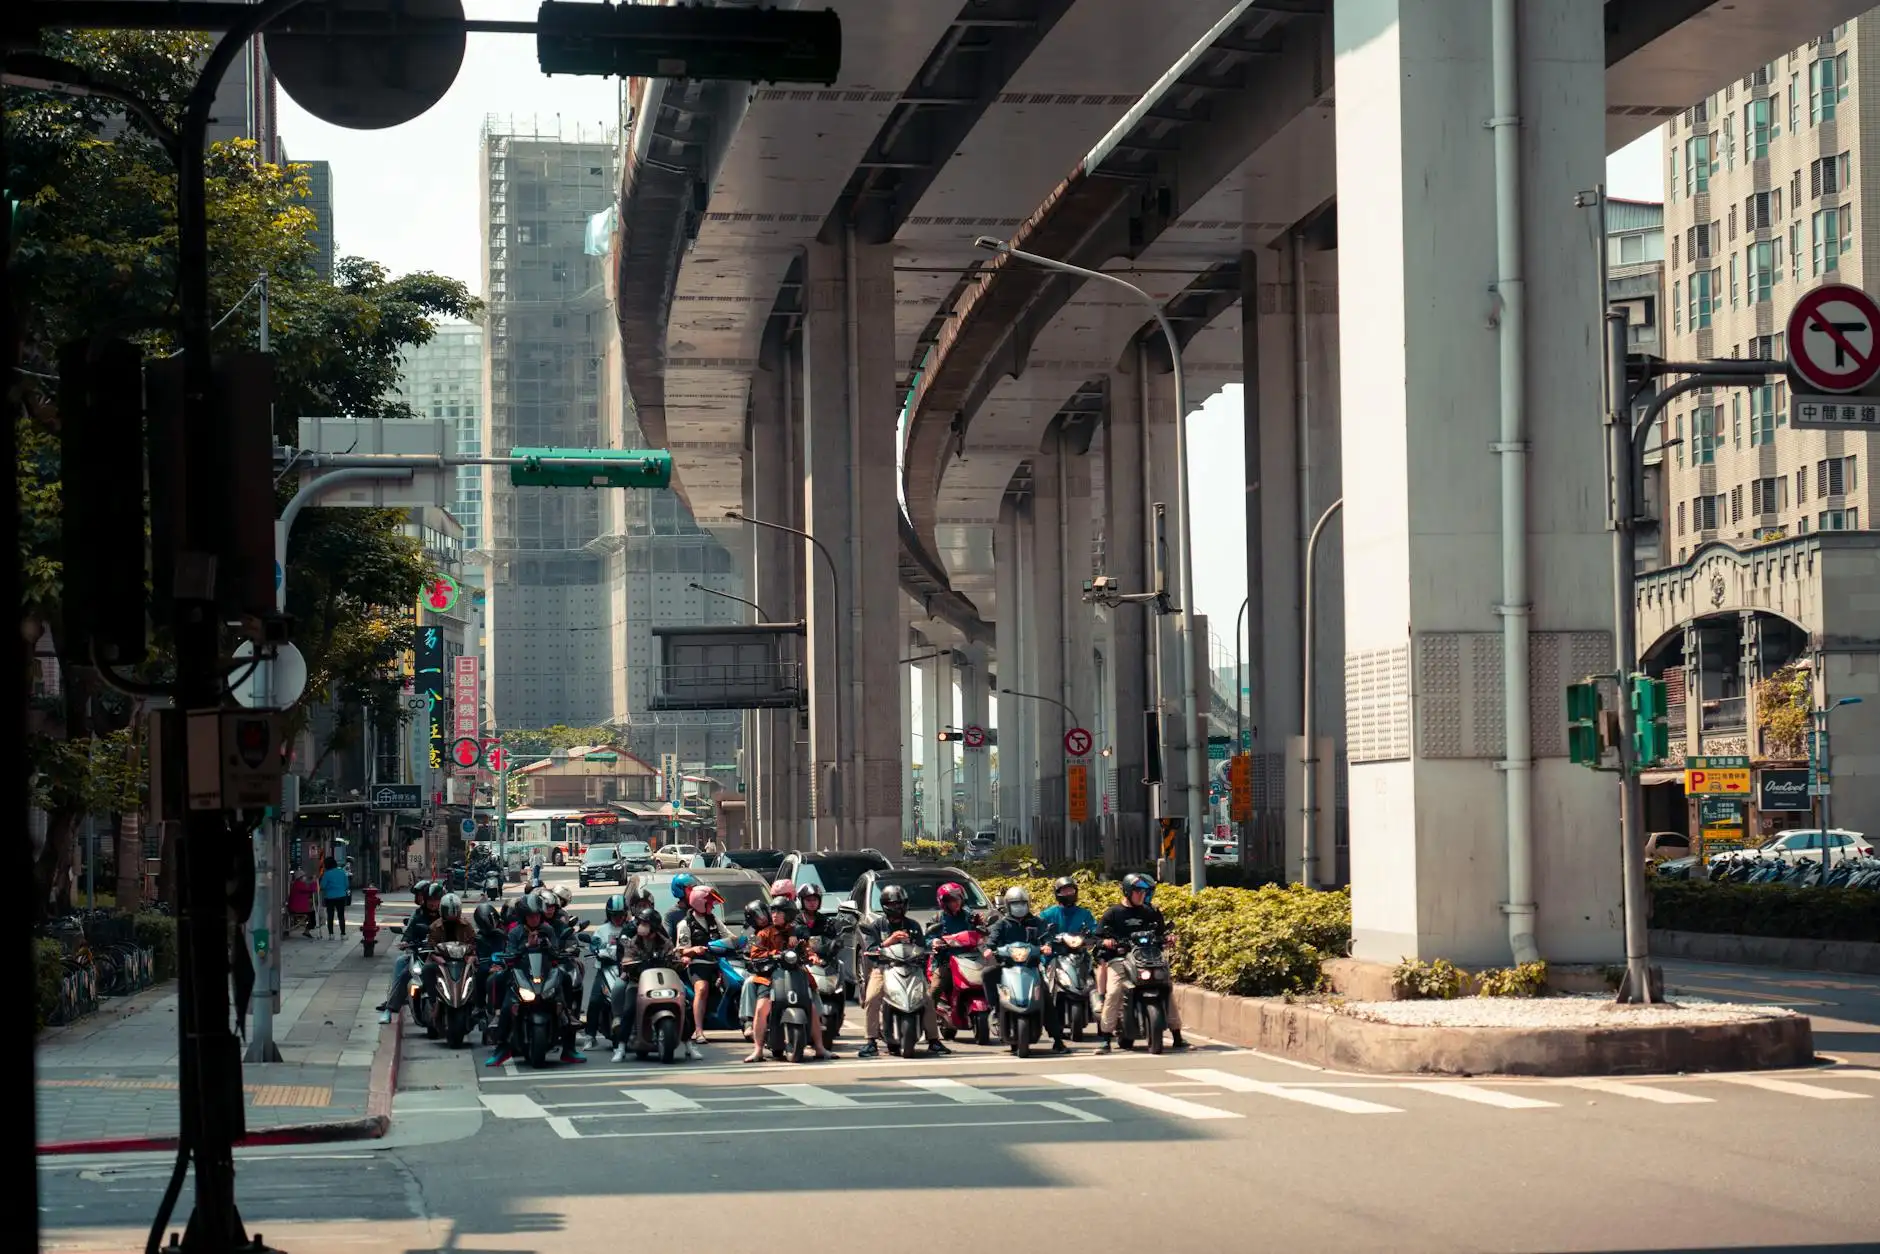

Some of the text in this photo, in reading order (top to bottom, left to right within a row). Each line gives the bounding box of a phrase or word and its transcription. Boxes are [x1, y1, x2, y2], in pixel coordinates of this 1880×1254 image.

[1802, 404, 1876, 422] 中間車道
[1691, 771, 1705, 792] P
